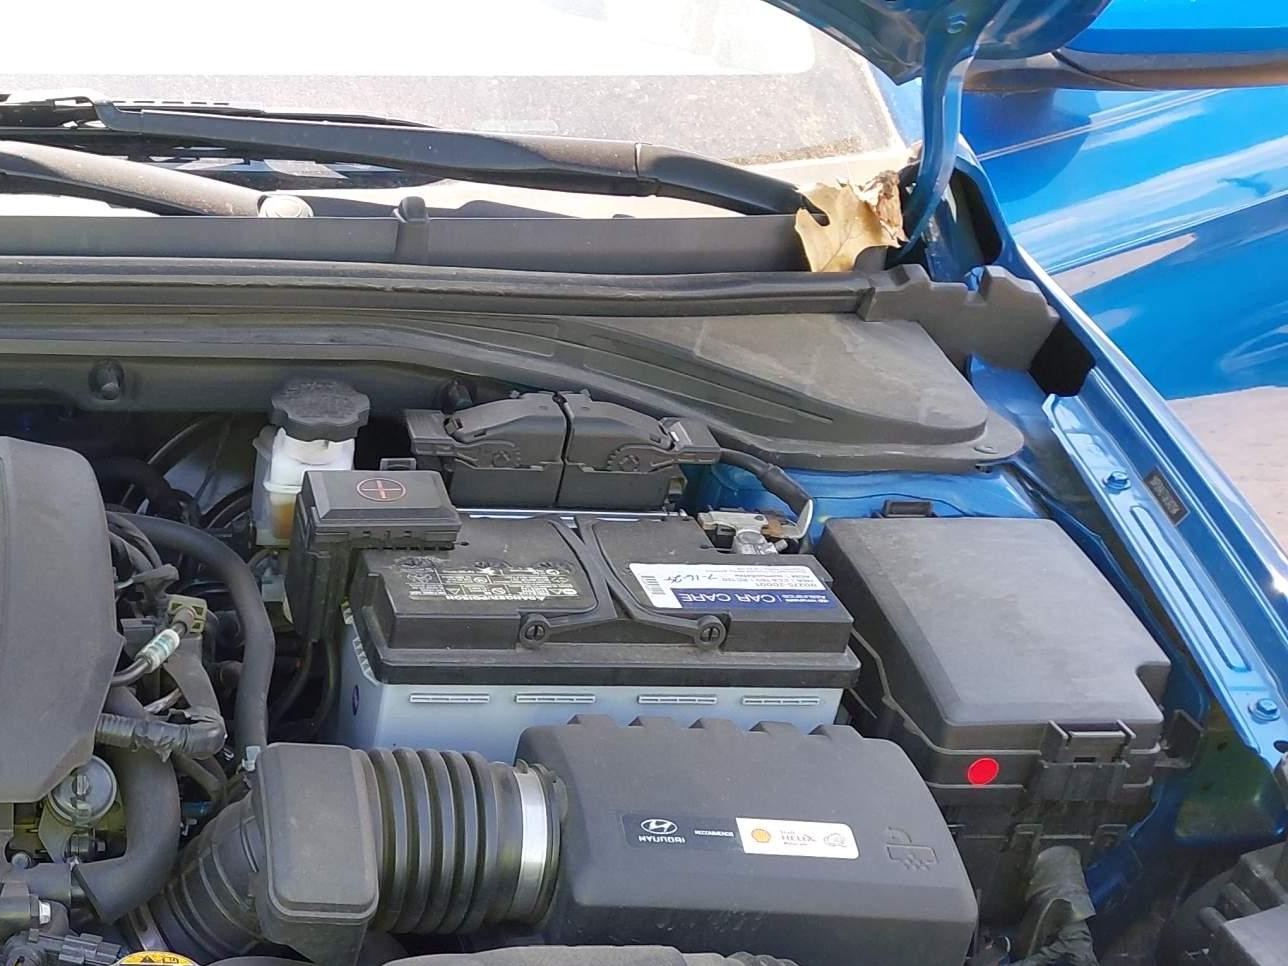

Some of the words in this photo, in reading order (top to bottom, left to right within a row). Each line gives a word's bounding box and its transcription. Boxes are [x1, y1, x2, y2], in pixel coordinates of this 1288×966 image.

[678, 593, 731, 602] CARE
[735, 593, 776, 603] CAR
[638, 835, 686, 844] HYUNDAI
